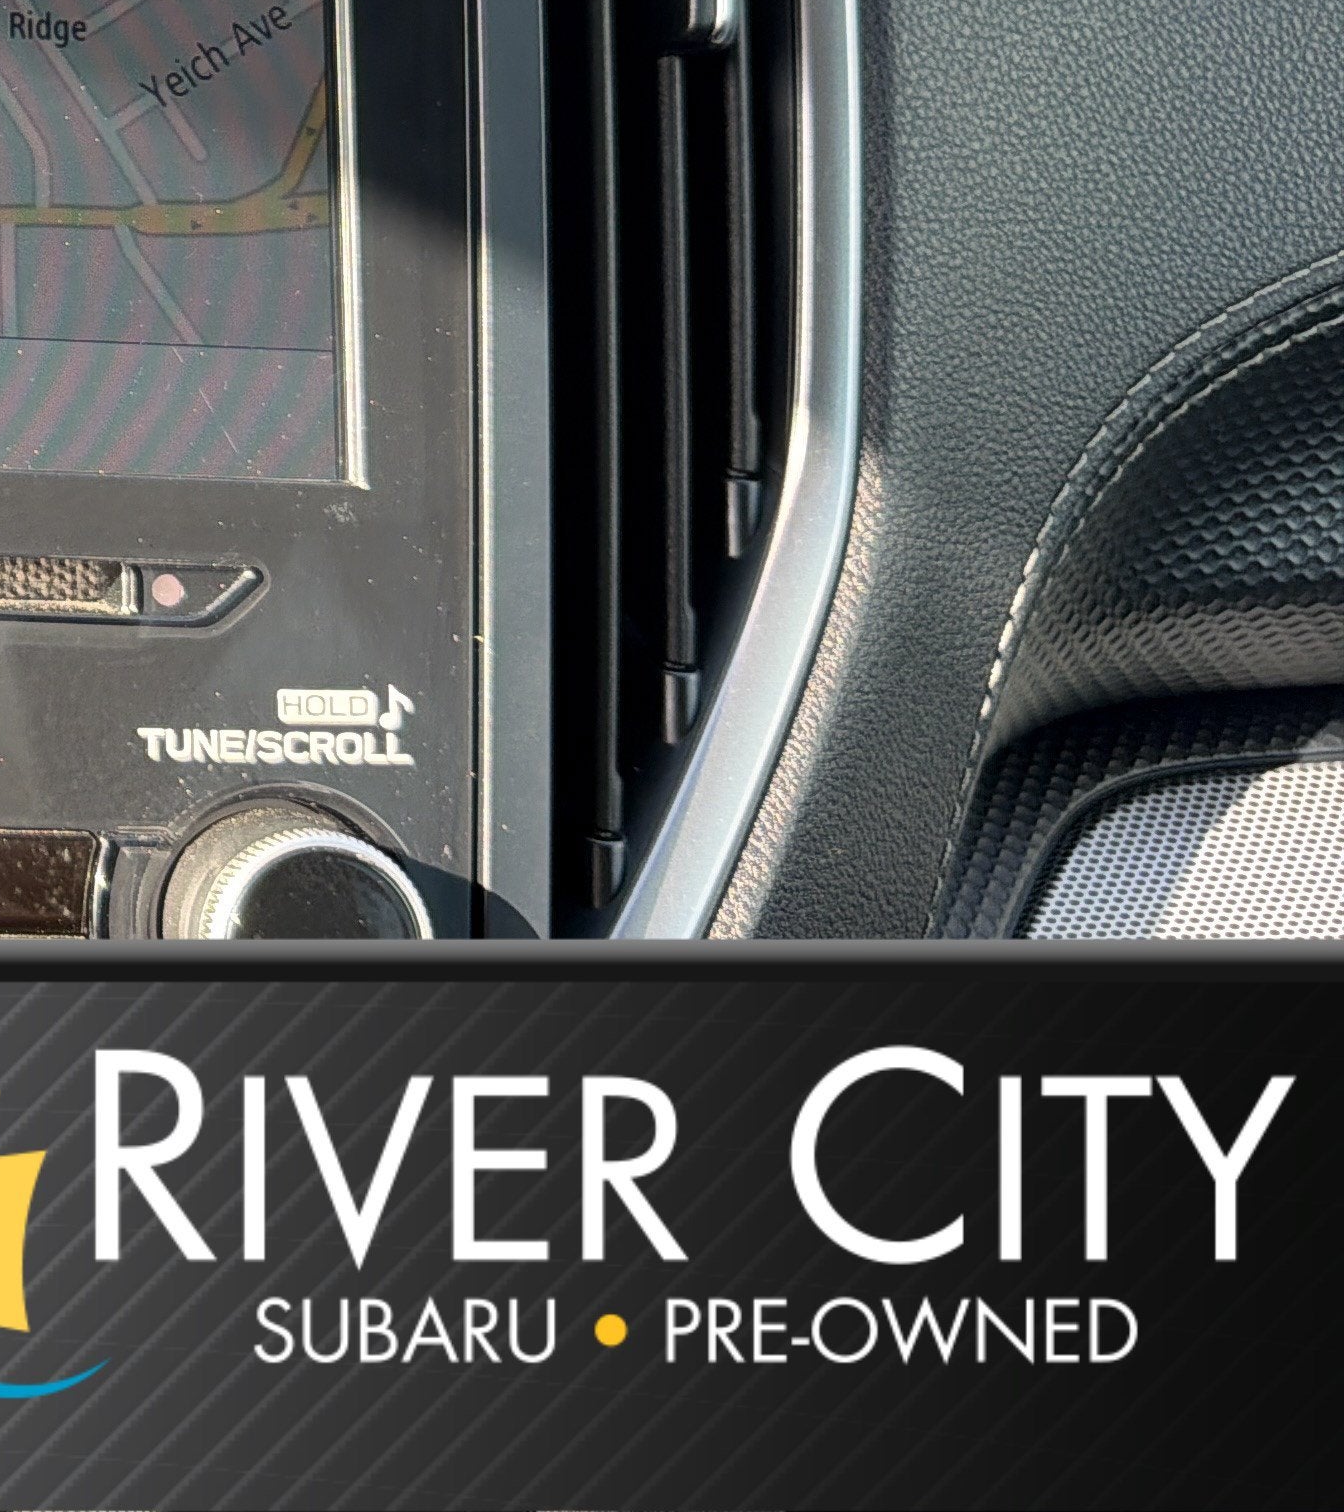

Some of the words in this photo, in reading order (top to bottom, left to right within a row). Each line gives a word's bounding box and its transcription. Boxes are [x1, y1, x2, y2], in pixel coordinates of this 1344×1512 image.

[10, 11, 88, 48] Ridge
[138, 41, 230, 109] Yeich
[232, 3, 293, 49] Ave
[282, 694, 369, 717] HOLD
[137, 726, 415, 766] TUNE/SCROLL
